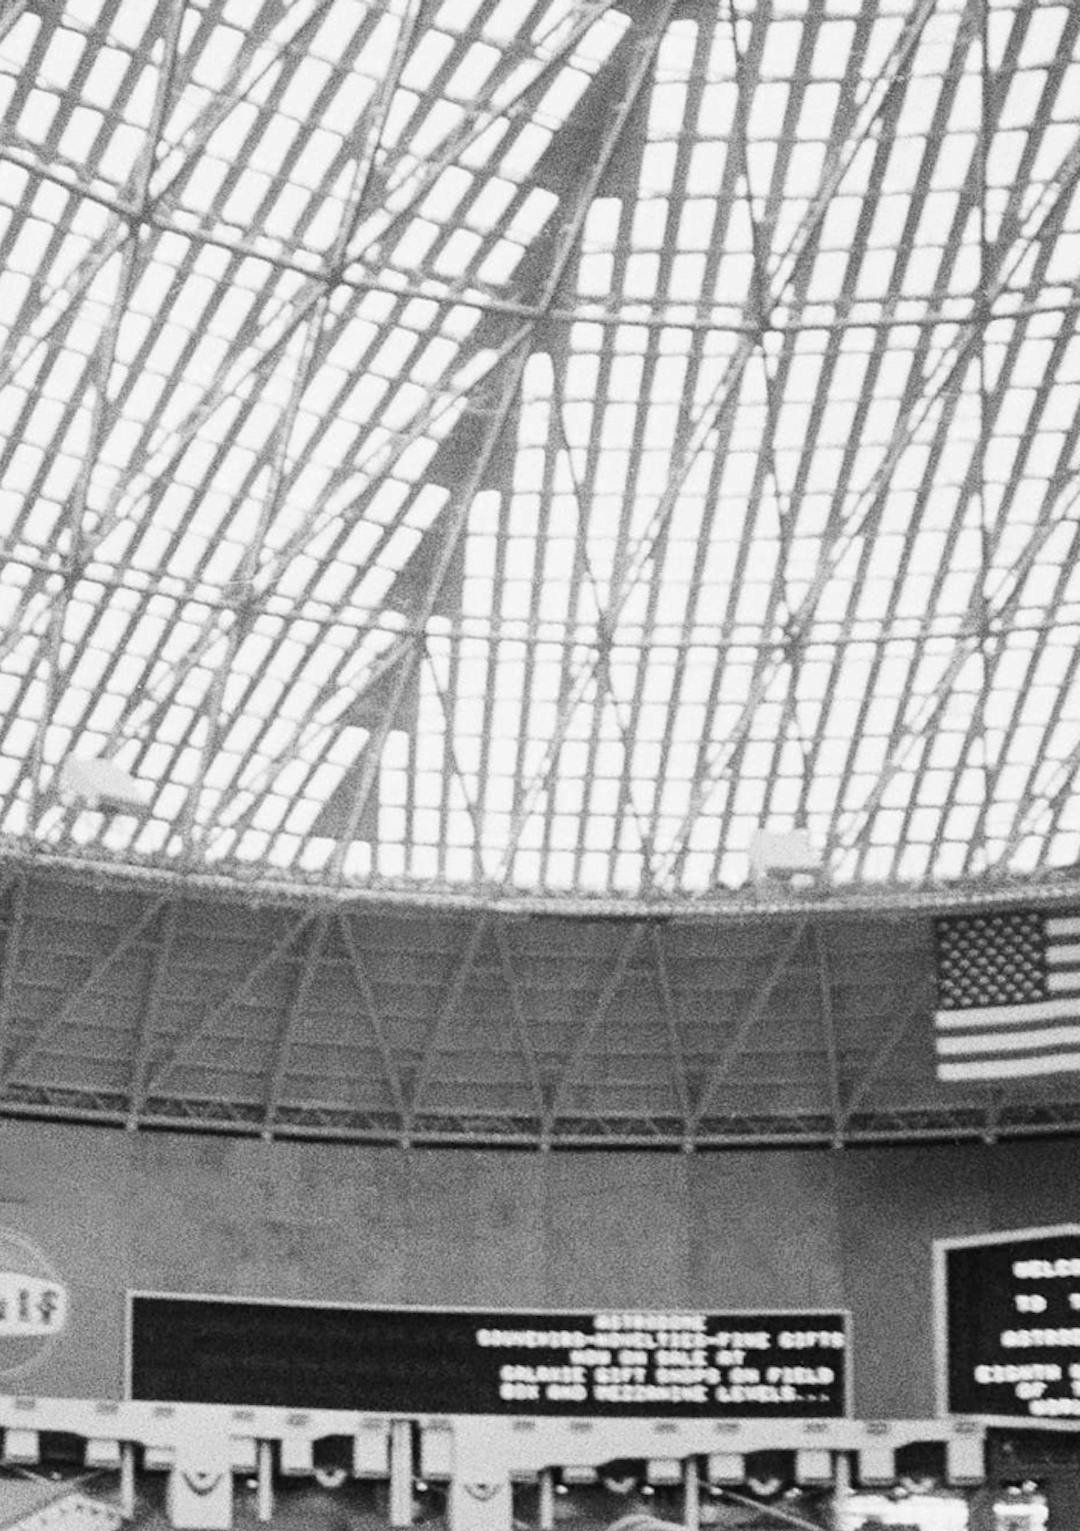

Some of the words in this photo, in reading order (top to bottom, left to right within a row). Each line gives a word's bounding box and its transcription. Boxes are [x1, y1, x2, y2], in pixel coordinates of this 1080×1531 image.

[779, 1331, 844, 1348] GIFTS
[655, 1349, 707, 1366] SALE
[716, 1349, 745, 1365] AT
[767, 1367, 834, 1385] FIELD
